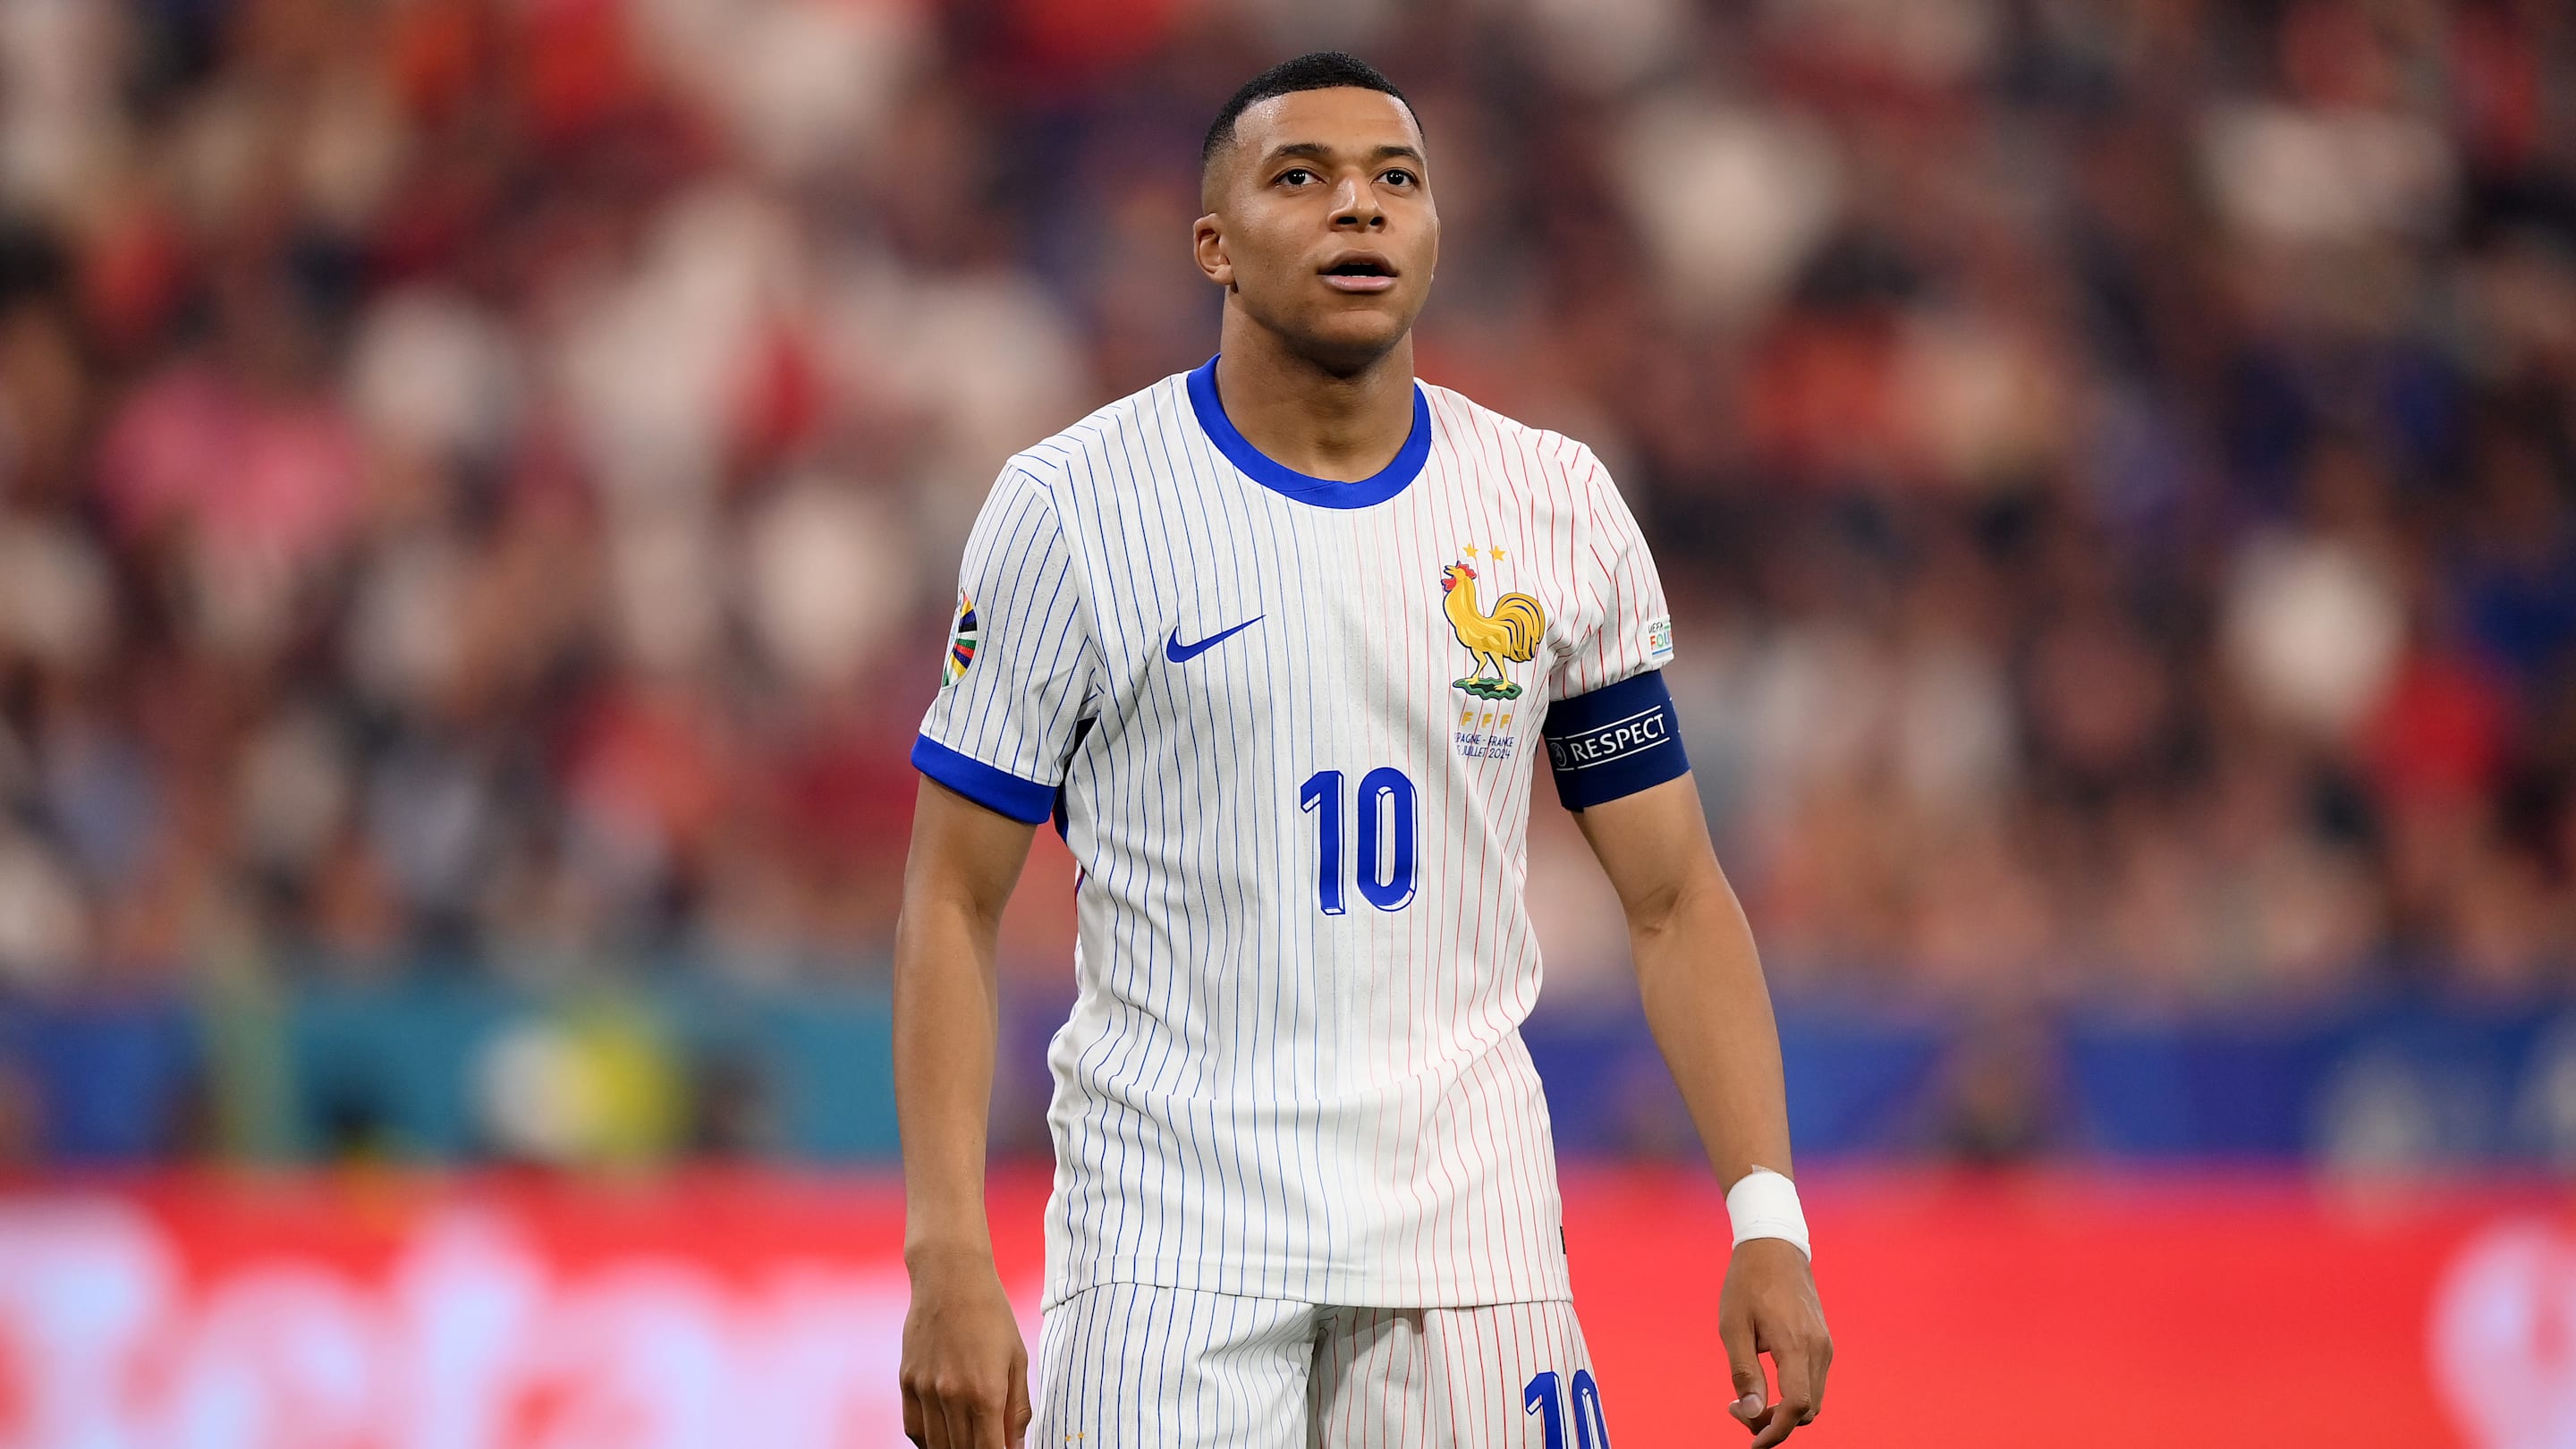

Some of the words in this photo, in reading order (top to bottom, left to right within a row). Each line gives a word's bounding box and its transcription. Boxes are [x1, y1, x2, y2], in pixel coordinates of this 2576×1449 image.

[1648, 622, 1663, 634] UEFA
[1487, 735, 1514, 747] FRANCE
[1570, 714, 1665, 761] RESPECT
[1488, 748, 1511, 758] 2024
[1301, 767, 1418, 915] 10
[1524, 1369, 1610, 1449] 10
